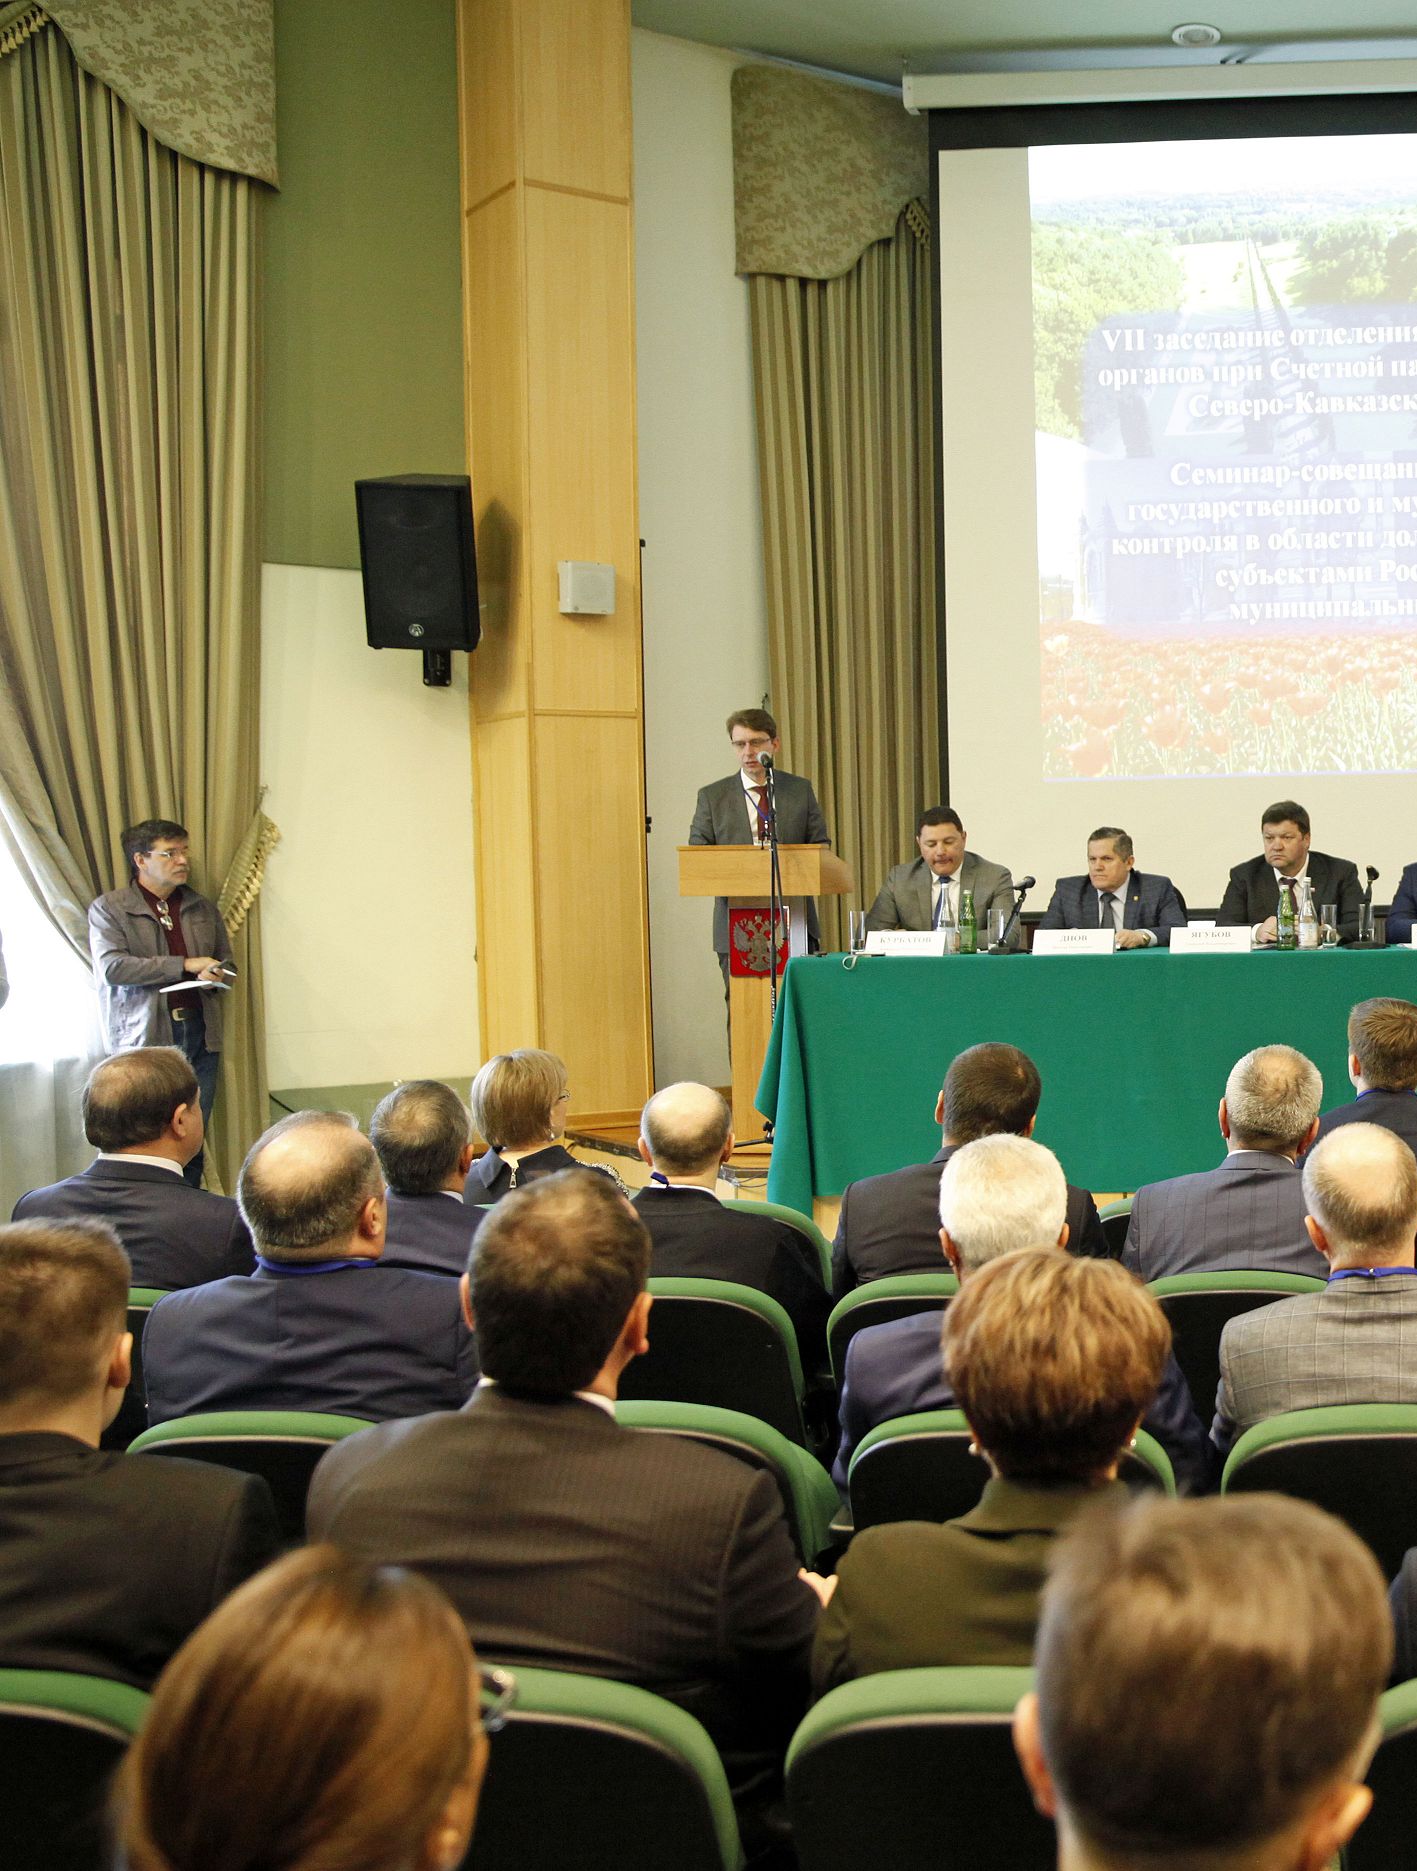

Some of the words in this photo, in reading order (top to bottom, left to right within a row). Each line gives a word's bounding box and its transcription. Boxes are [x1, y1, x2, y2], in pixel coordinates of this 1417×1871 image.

[1101, 329, 1146, 351] VII
[1153, 325, 1285, 351] заседание
[1098, 366, 1204, 388] органов
[1212, 364, 1262, 386] при
[1270, 355, 1384, 381] Счетной
[1127, 495, 1361, 525] государственного
[1367, 496, 1385, 513] и
[1111, 532, 1239, 559] контроля
[1245, 532, 1261, 550] в
[1268, 526, 1374, 550] области
[1215, 560, 1373, 590] субъектами
